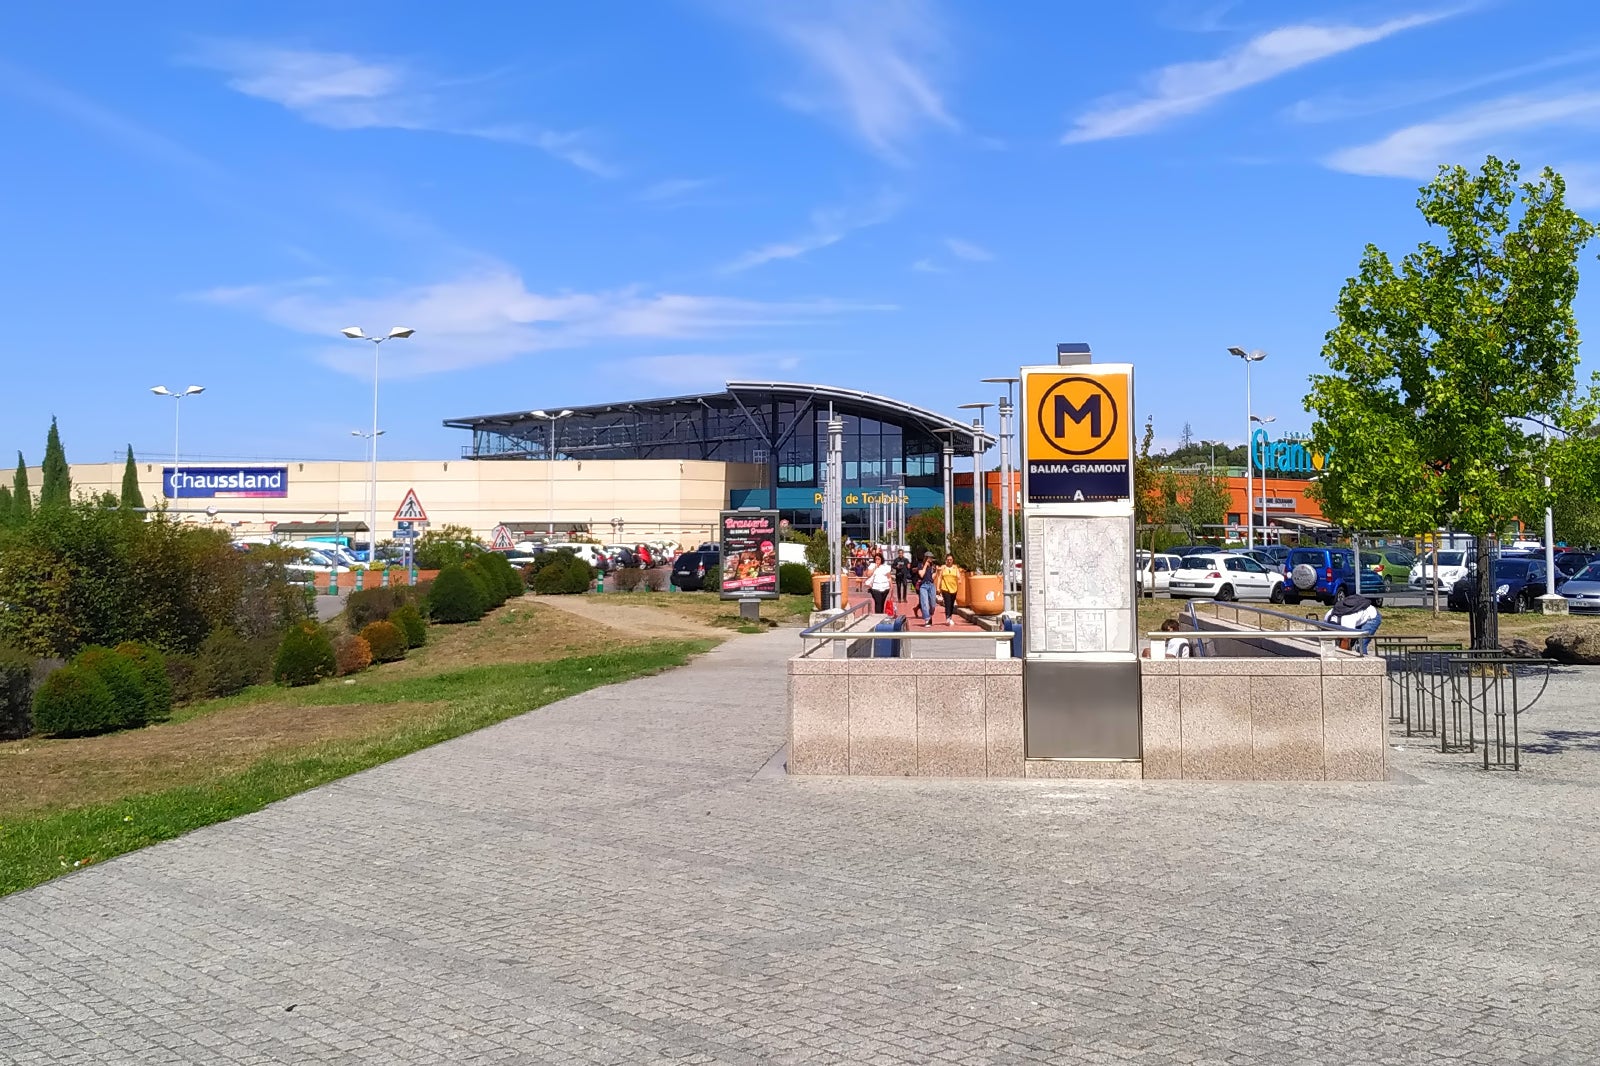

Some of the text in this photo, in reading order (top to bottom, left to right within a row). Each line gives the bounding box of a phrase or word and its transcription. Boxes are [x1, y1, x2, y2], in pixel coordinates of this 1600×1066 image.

[1054, 394, 1101, 438] M
[1030, 464, 1127, 474] BALMA-GRAMONT
[170, 471, 281, 489] Chaussland
[845, 493, 858, 504] de
[861, 492, 909, 505] Touloue
[1073, 489, 1085, 501] A
